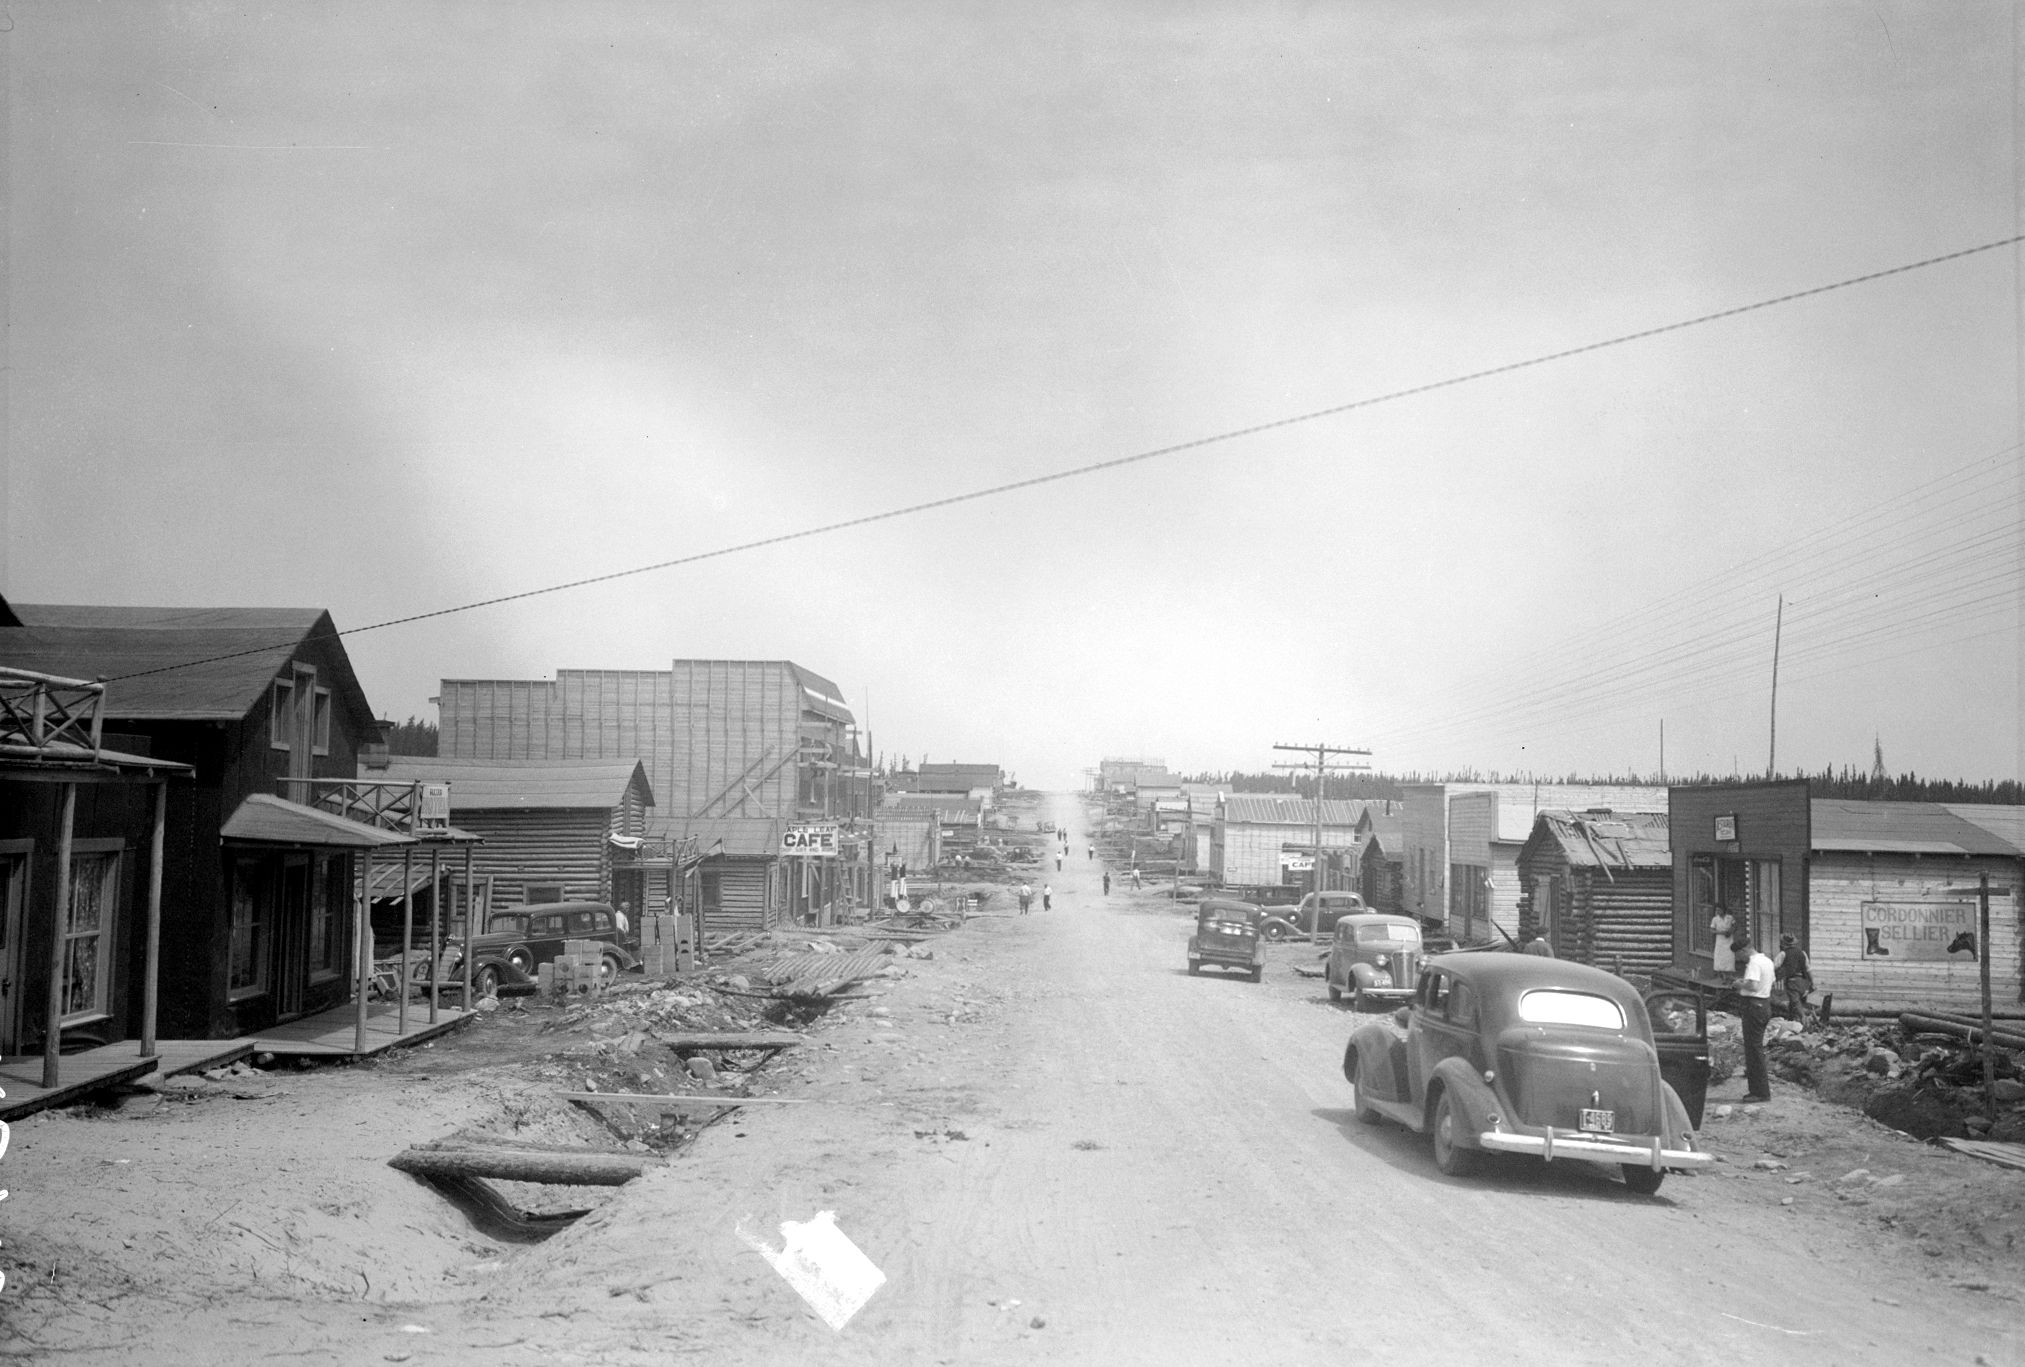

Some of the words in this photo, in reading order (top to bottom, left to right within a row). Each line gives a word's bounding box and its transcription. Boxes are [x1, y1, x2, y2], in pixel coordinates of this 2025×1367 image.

[784, 833, 833, 847] CAFE
[1866, 907, 1966, 923] CORDONNIER
[1881, 925, 1950, 941] SELLIER
